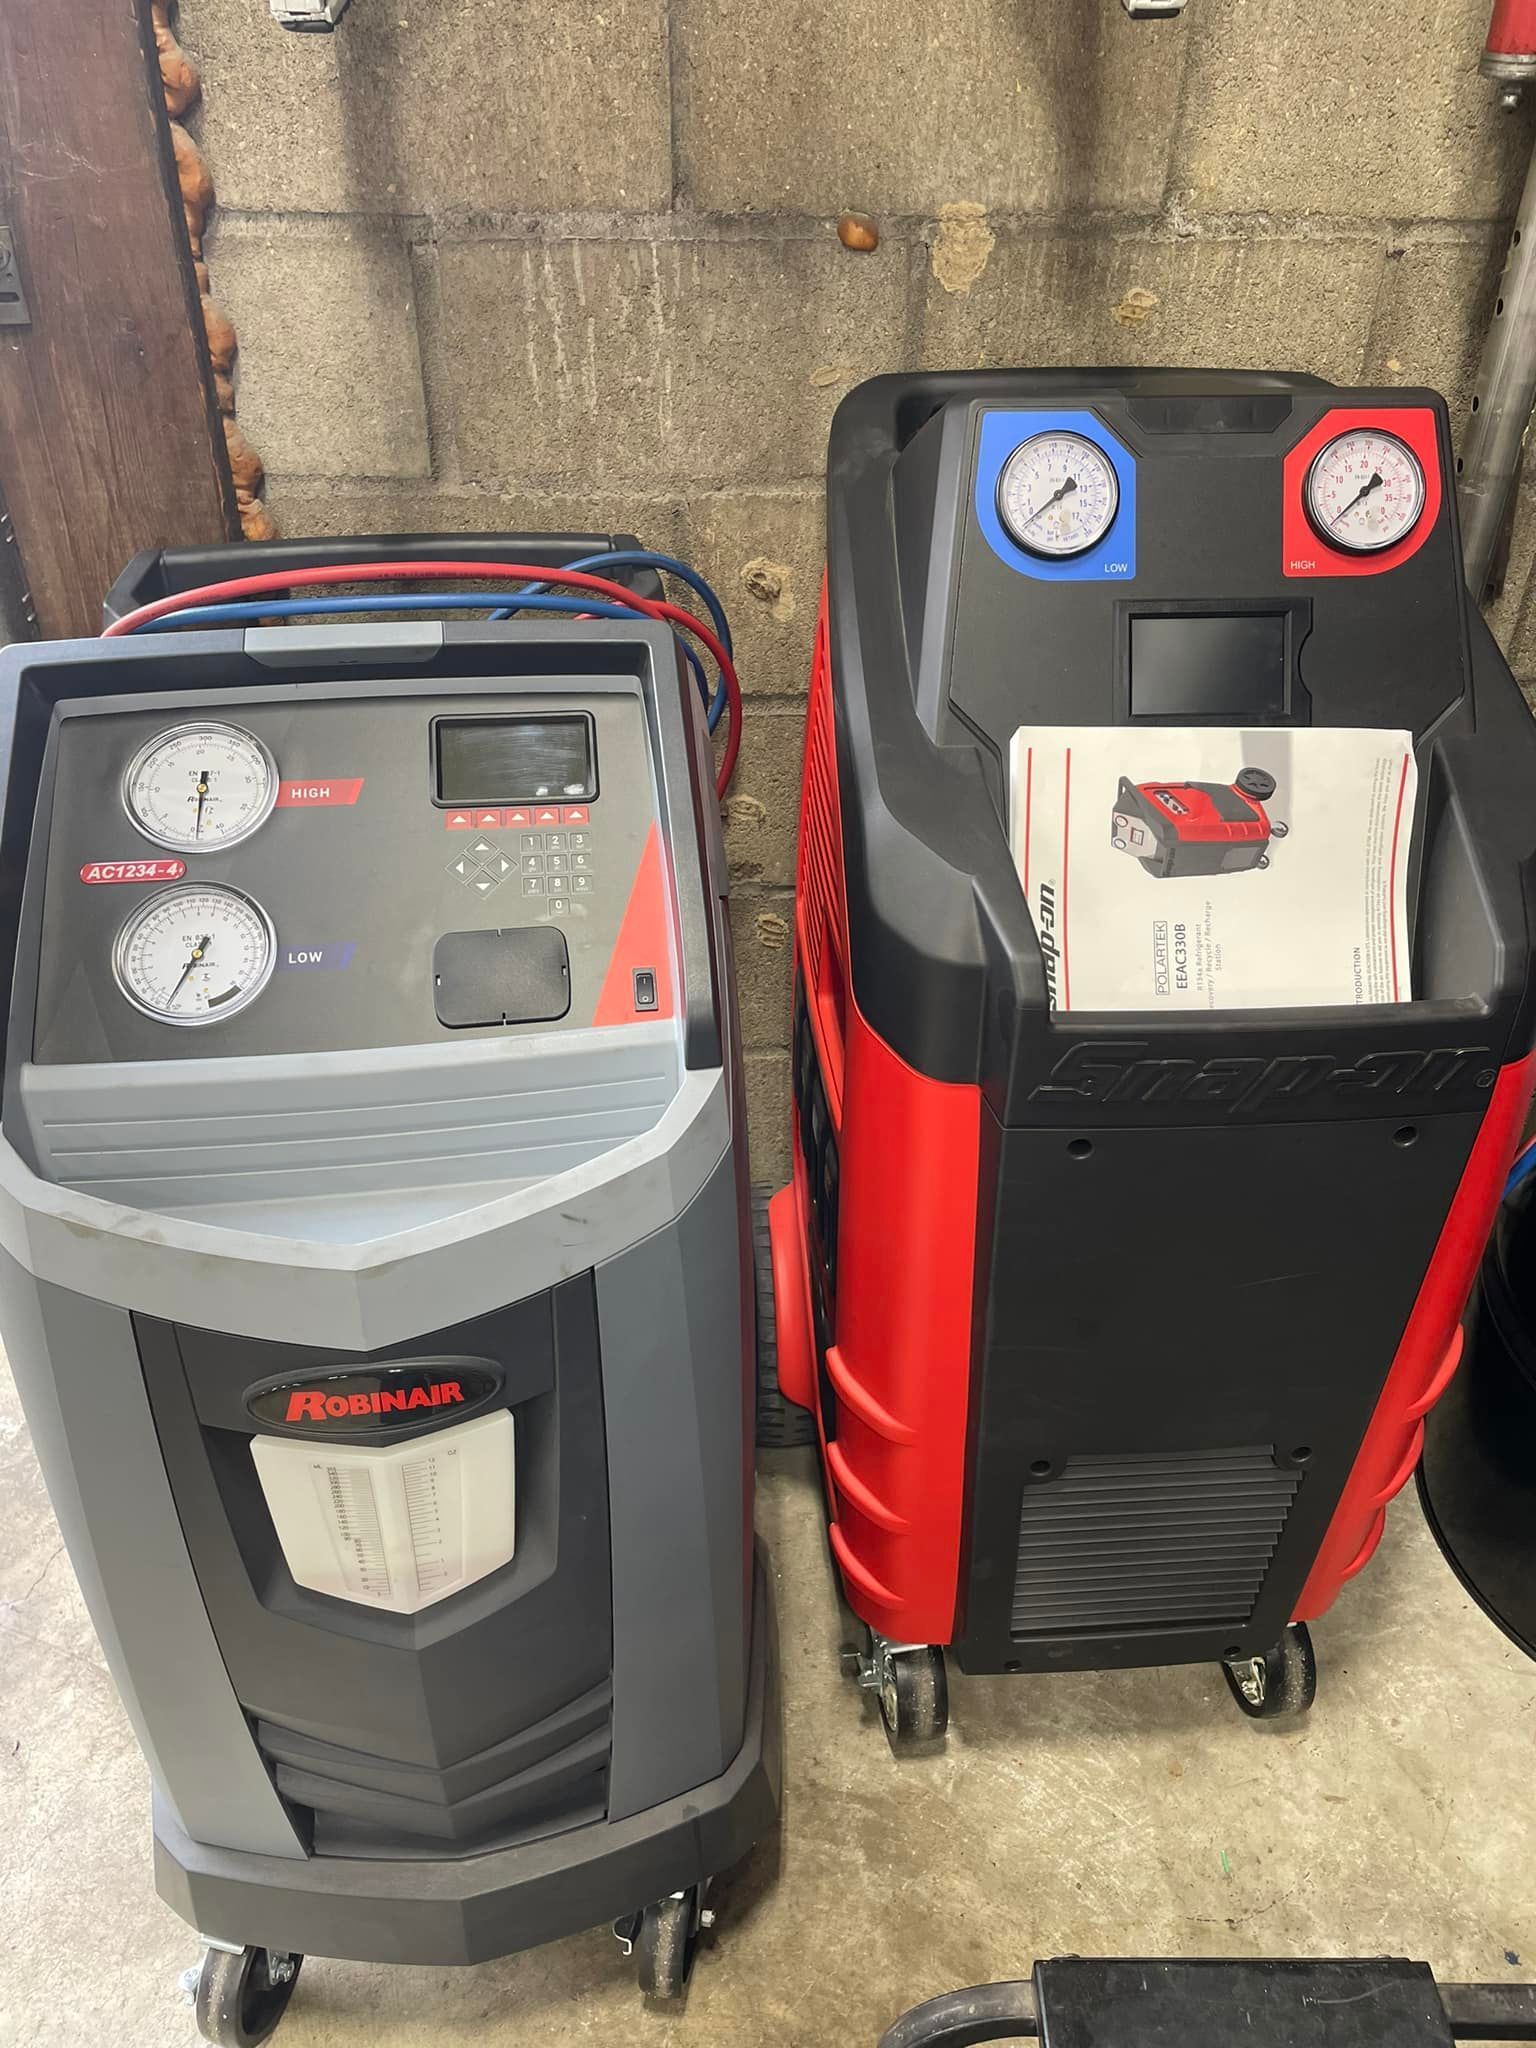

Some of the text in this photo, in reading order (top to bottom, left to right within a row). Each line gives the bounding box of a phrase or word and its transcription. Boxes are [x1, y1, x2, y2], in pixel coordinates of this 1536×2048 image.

[1063, 464, 1067, 472] 9
[1360, 460, 1368, 468] 20
[1375, 466, 1383, 474] 25
[1035, 471, 1039, 479] 5
[1336, 476, 1344, 484] 10
[1027, 484, 1031, 492] 3
[1080, 485, 1087, 493] 13
[1385, 494, 1393, 502] 35
[1080, 500, 1087, 508] 15
[1029, 507, 1034, 515] 0
[1072, 512, 1079, 520] 17
[1104, 563, 1128, 573] LOW
[1290, 560, 1316, 570] HIGH
[291, 787, 330, 799] HIGH
[528, 837, 533, 845] 1
[552, 836, 559, 844] 2
[576, 835, 583, 843] 3
[529, 857, 535, 866] 4
[554, 856, 560, 865] 5
[577, 855, 584, 864] 6
[86, 862, 178, 880] AC1234-4
[530, 880, 537, 888] 7
[554, 879, 561, 887] 8
[578, 877, 585, 886] 9
[556, 900, 562, 908] 0
[1203, 900, 1211, 936] Recharge
[1195, 924, 1203, 966] Refrigerant
[288, 951, 323, 964] LOW
[1155, 923, 1168, 994] POLARTEK
[1174, 923, 1188, 989] EEAC330B
[1204, 944, 1213, 972] Recycle
[1353, 947, 1363, 1004] TRODUCTION
[1206, 980, 1215, 1008] ecovery
[1028, 1041, 1490, 1113] Snap-on
